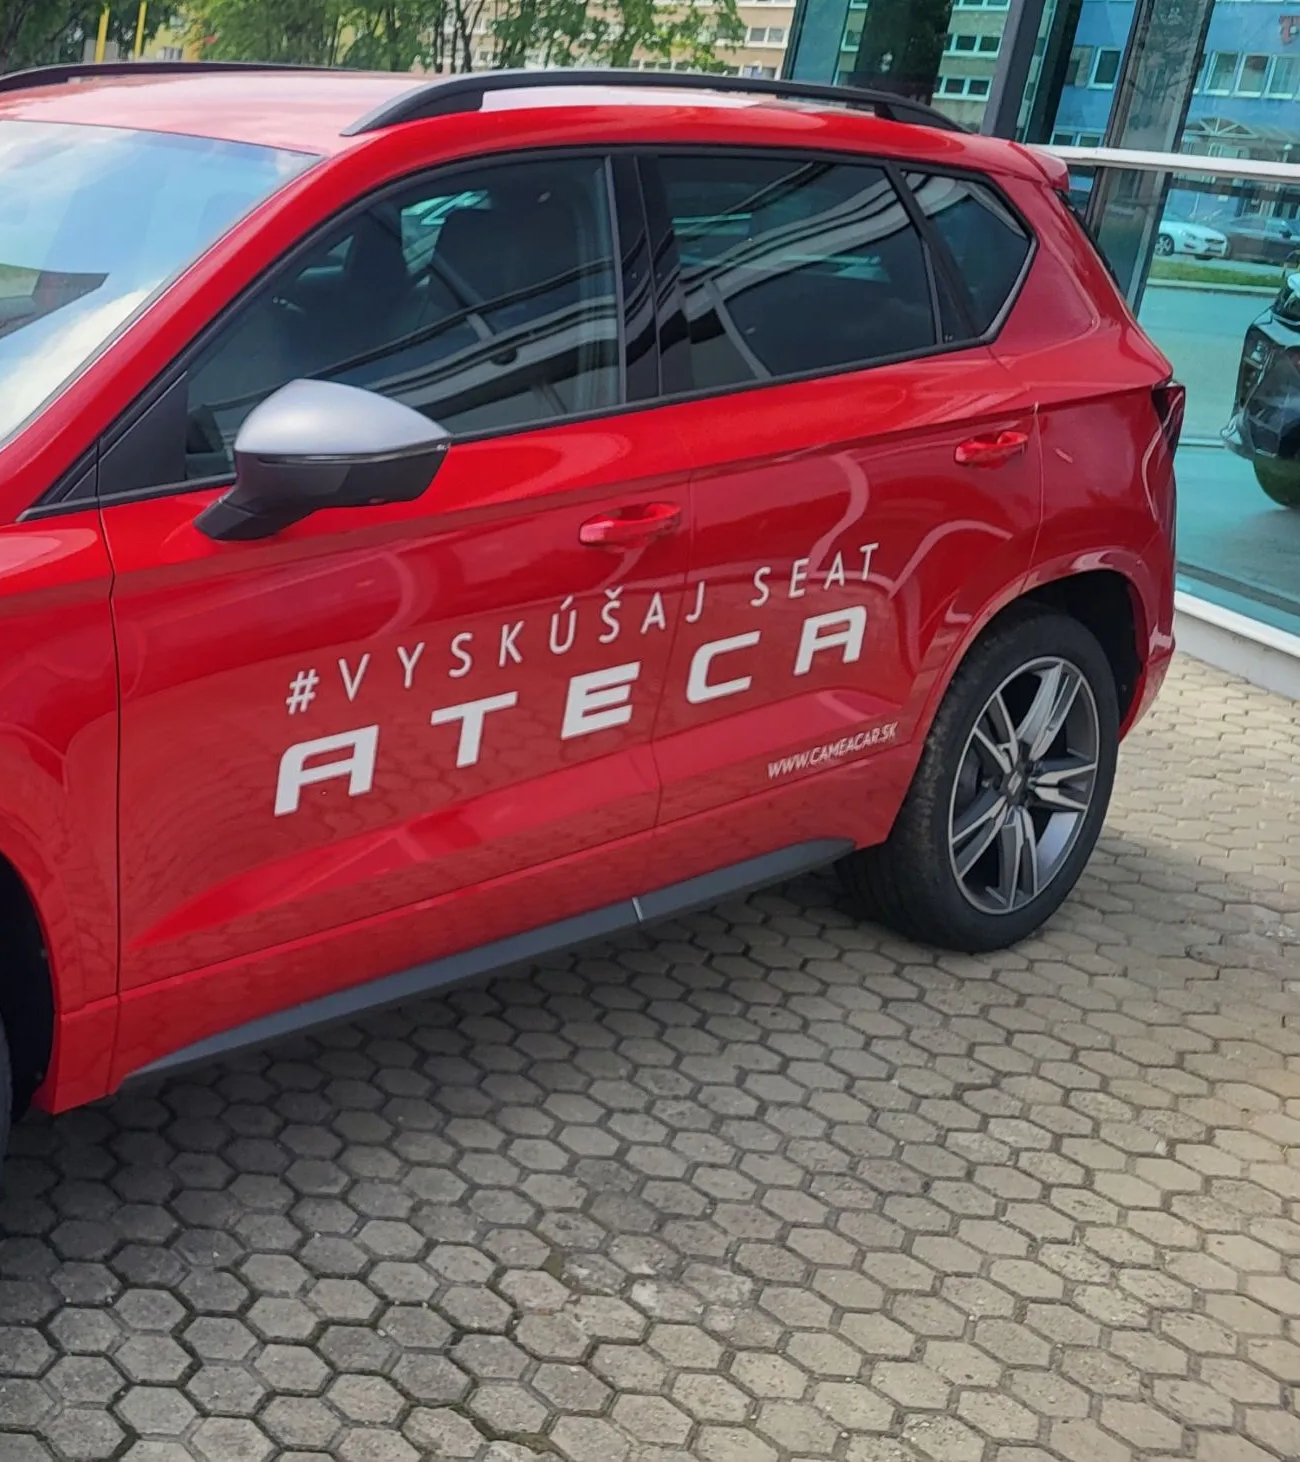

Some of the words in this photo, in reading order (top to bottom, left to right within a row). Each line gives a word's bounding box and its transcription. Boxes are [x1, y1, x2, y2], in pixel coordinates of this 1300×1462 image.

[273, 605, 868, 817] ATECA
[286, 581, 707, 714] #VYSKÚŠAJ
[750, 542, 880, 608] SEAT
[766, 721, 899, 780] WWW.CAMEACAR.SK
